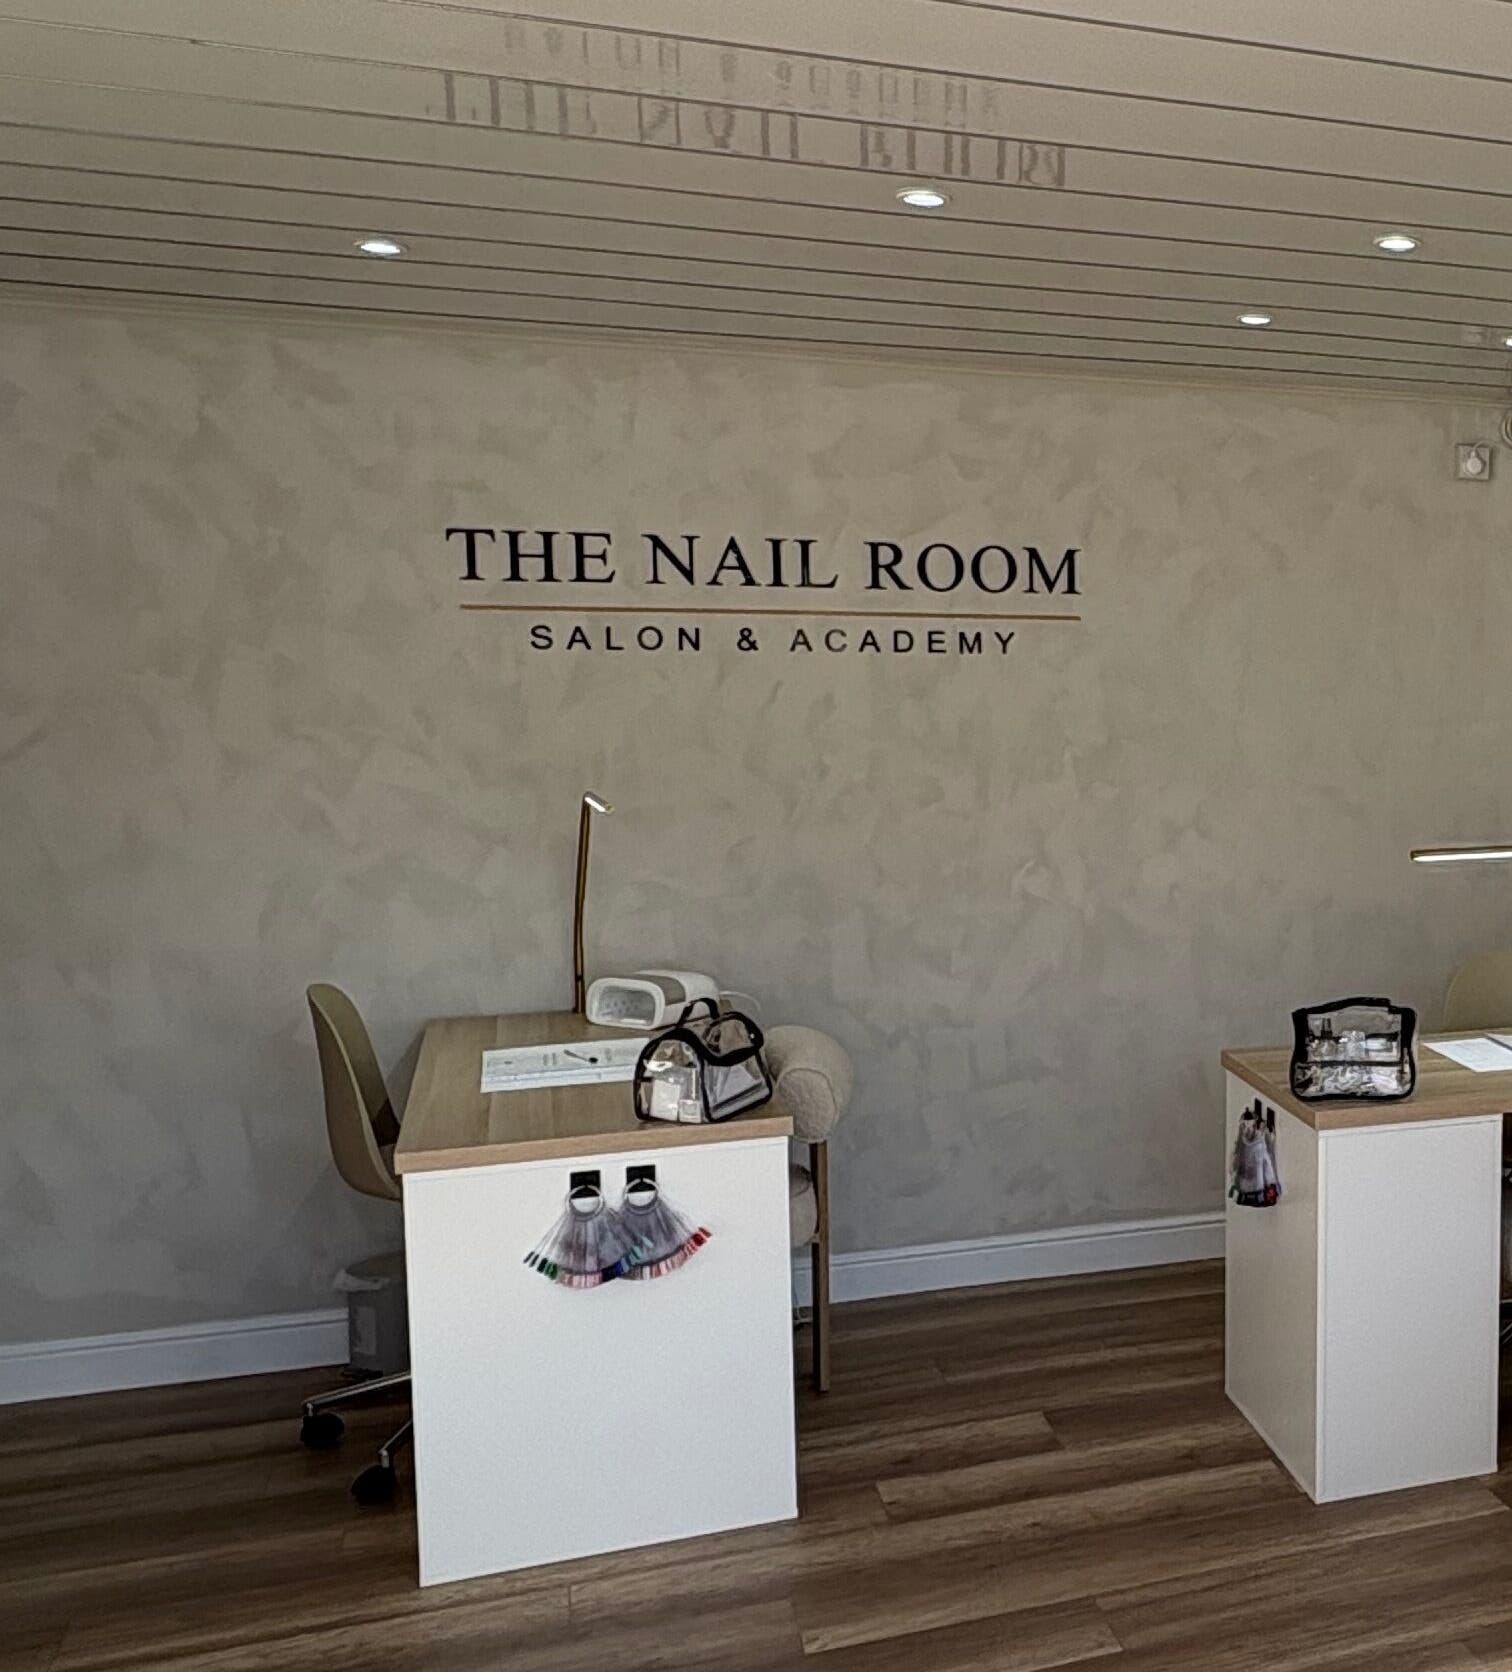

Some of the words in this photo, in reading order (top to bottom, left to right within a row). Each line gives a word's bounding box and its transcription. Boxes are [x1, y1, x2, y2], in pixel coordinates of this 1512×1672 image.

[445, 527, 616, 585] THE
[641, 533, 839, 589] NAIL
[863, 541, 1081, 595] ROOM
[530, 624, 700, 652] SALON
[736, 627, 759, 652] &
[789, 629, 1016, 655] ACADEMY
